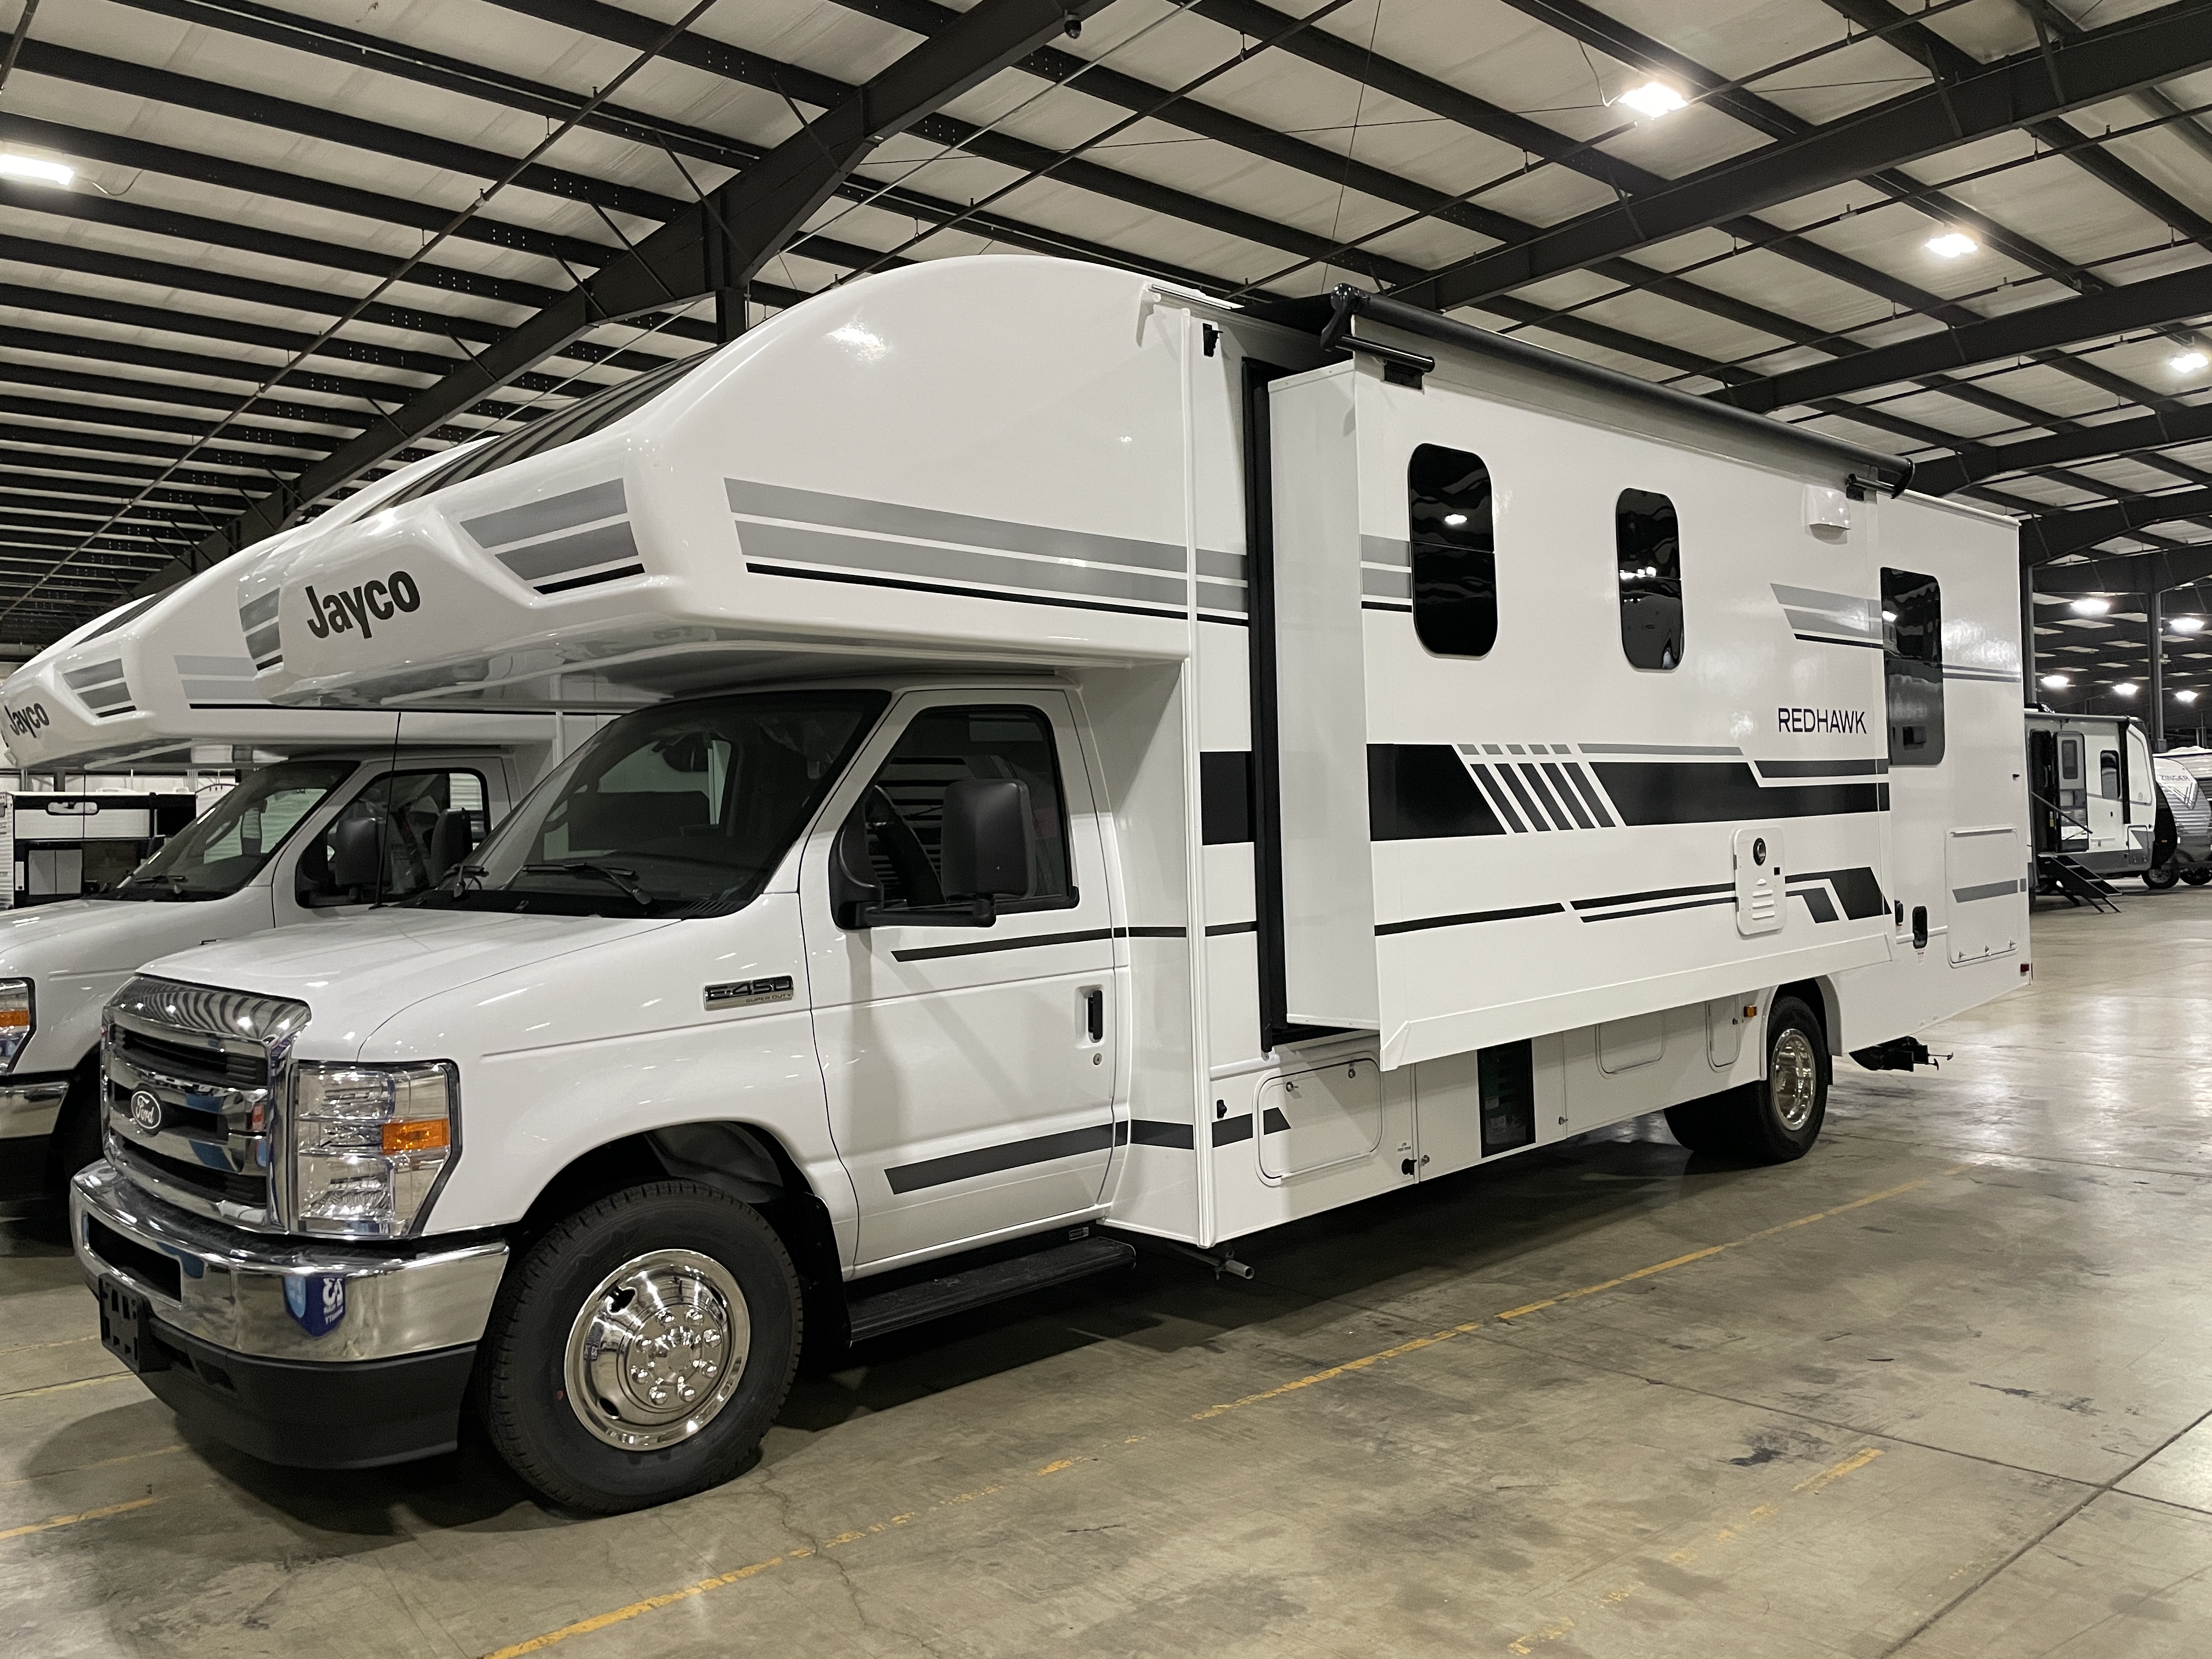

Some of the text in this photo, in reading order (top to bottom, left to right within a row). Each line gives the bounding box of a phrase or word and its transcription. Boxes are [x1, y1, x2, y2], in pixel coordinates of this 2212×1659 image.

[305, 571, 420, 639] Jayco
[4, 703, 49, 738] Jayco
[1778, 707, 1867, 734] REDHAWK
[135, 1094, 155, 1125] Ford
